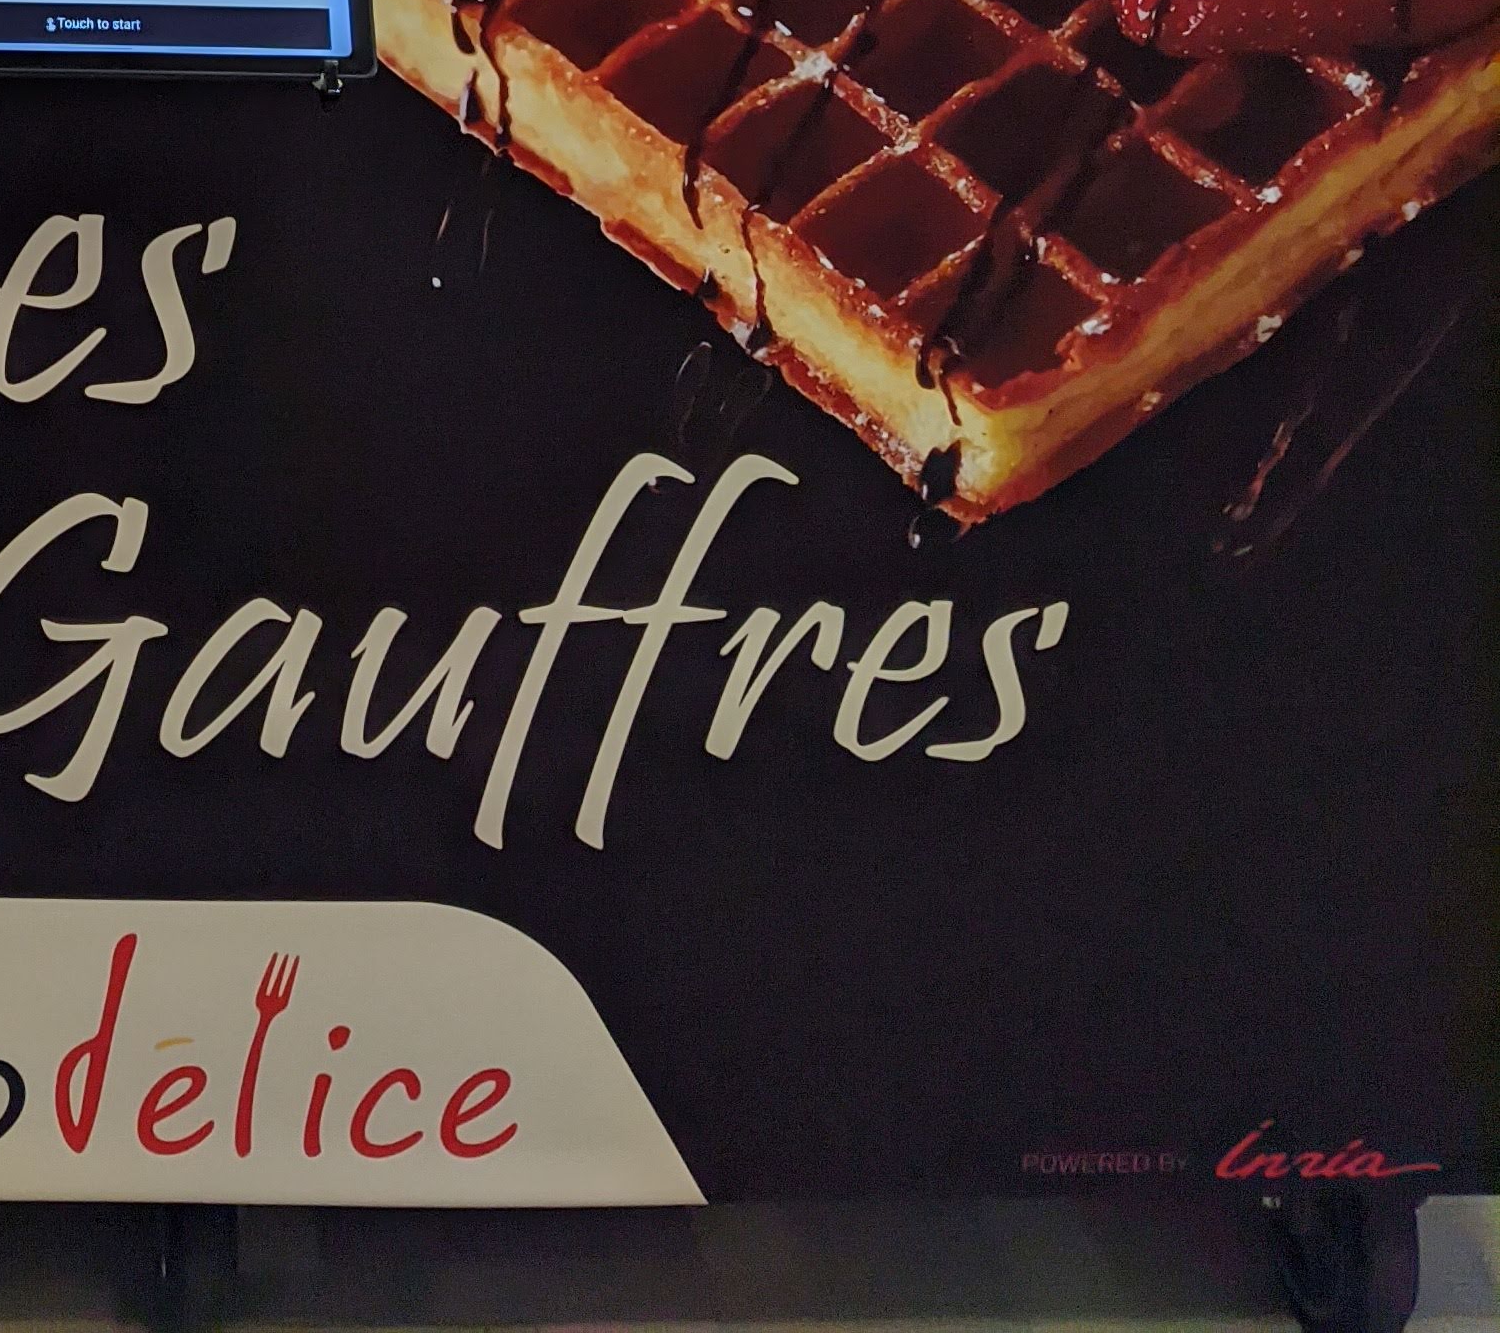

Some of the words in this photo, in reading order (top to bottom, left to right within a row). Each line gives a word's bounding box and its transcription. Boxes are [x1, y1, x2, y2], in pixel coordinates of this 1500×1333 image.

[57, 17, 94, 30] Touch
[97, 19, 110, 30] to
[112, 19, 141, 31] start
[1021, 1152, 1150, 1174] POWERED
